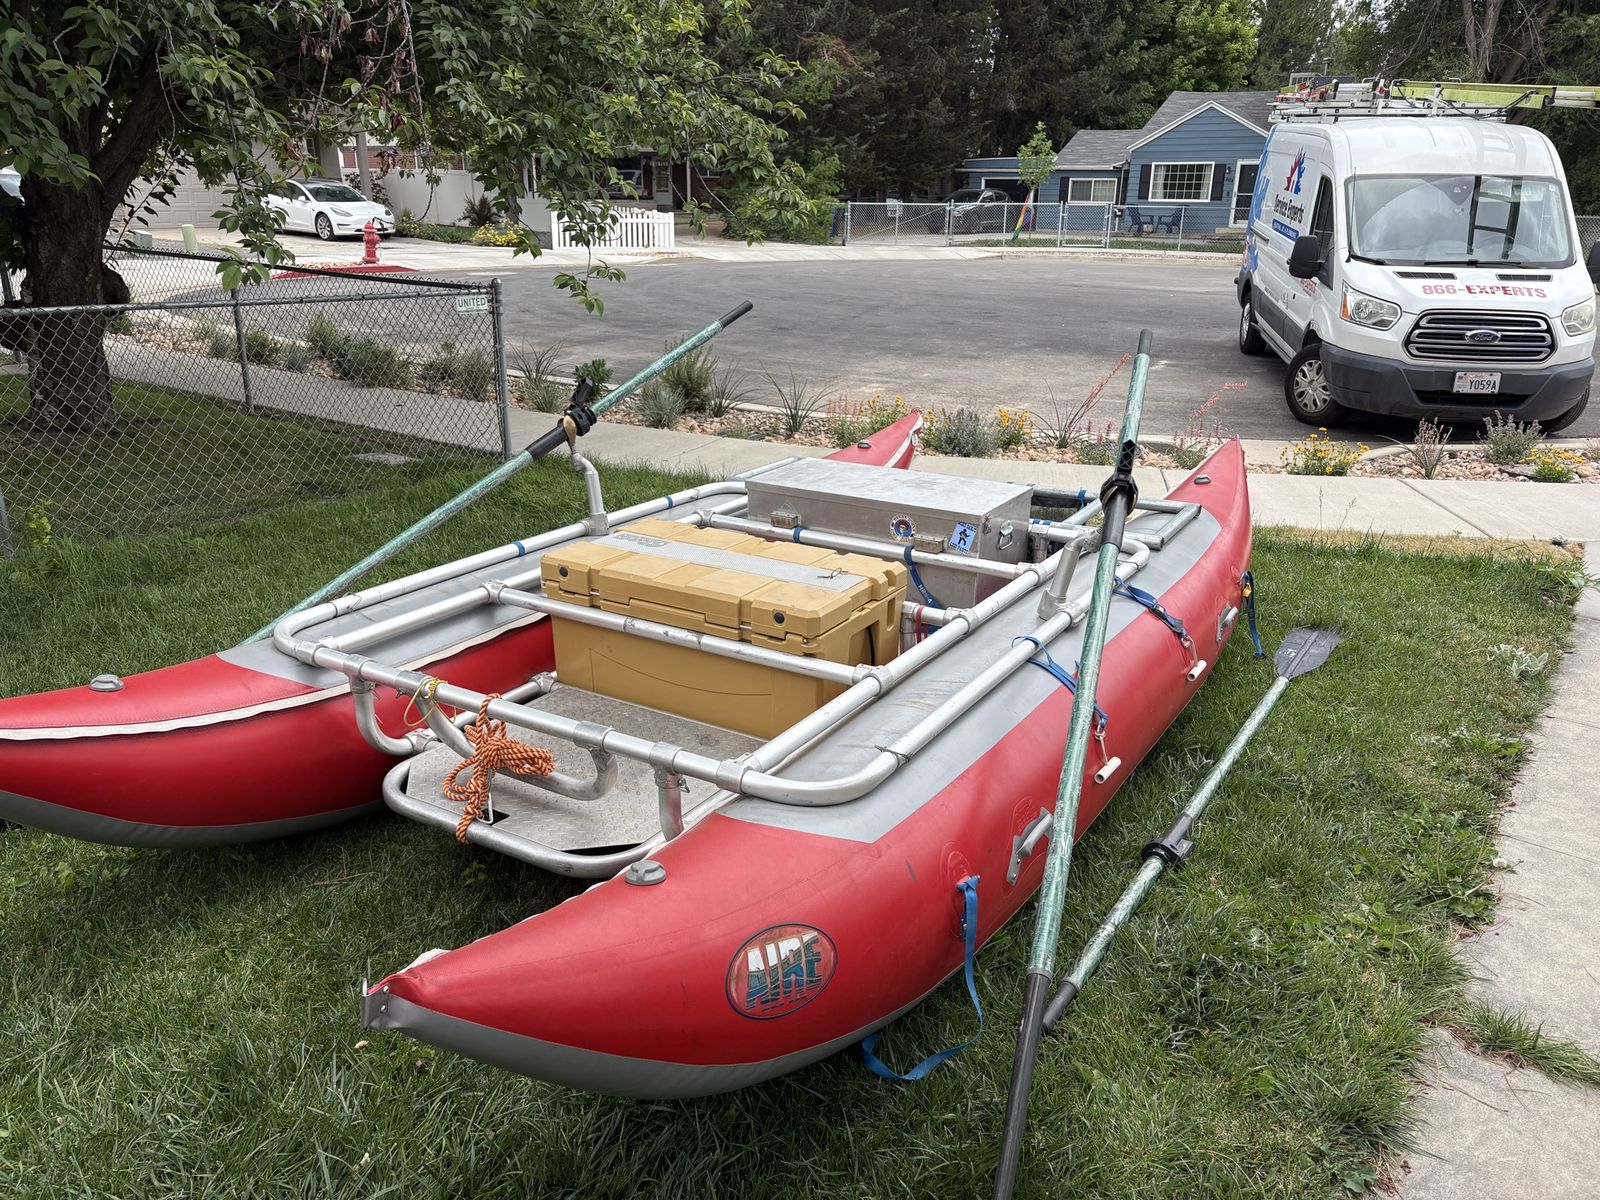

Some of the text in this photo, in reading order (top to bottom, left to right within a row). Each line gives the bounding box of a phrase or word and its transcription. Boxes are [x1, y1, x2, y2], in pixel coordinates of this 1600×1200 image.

[1274, 194, 1304, 224] Service Experts
[1422, 285, 1547, 298] 866-EXPERTS
[457, 298, 486, 308] UNITED
[1469, 379, 1496, 390] Y059A
[745, 931, 822, 1009] AIRE
